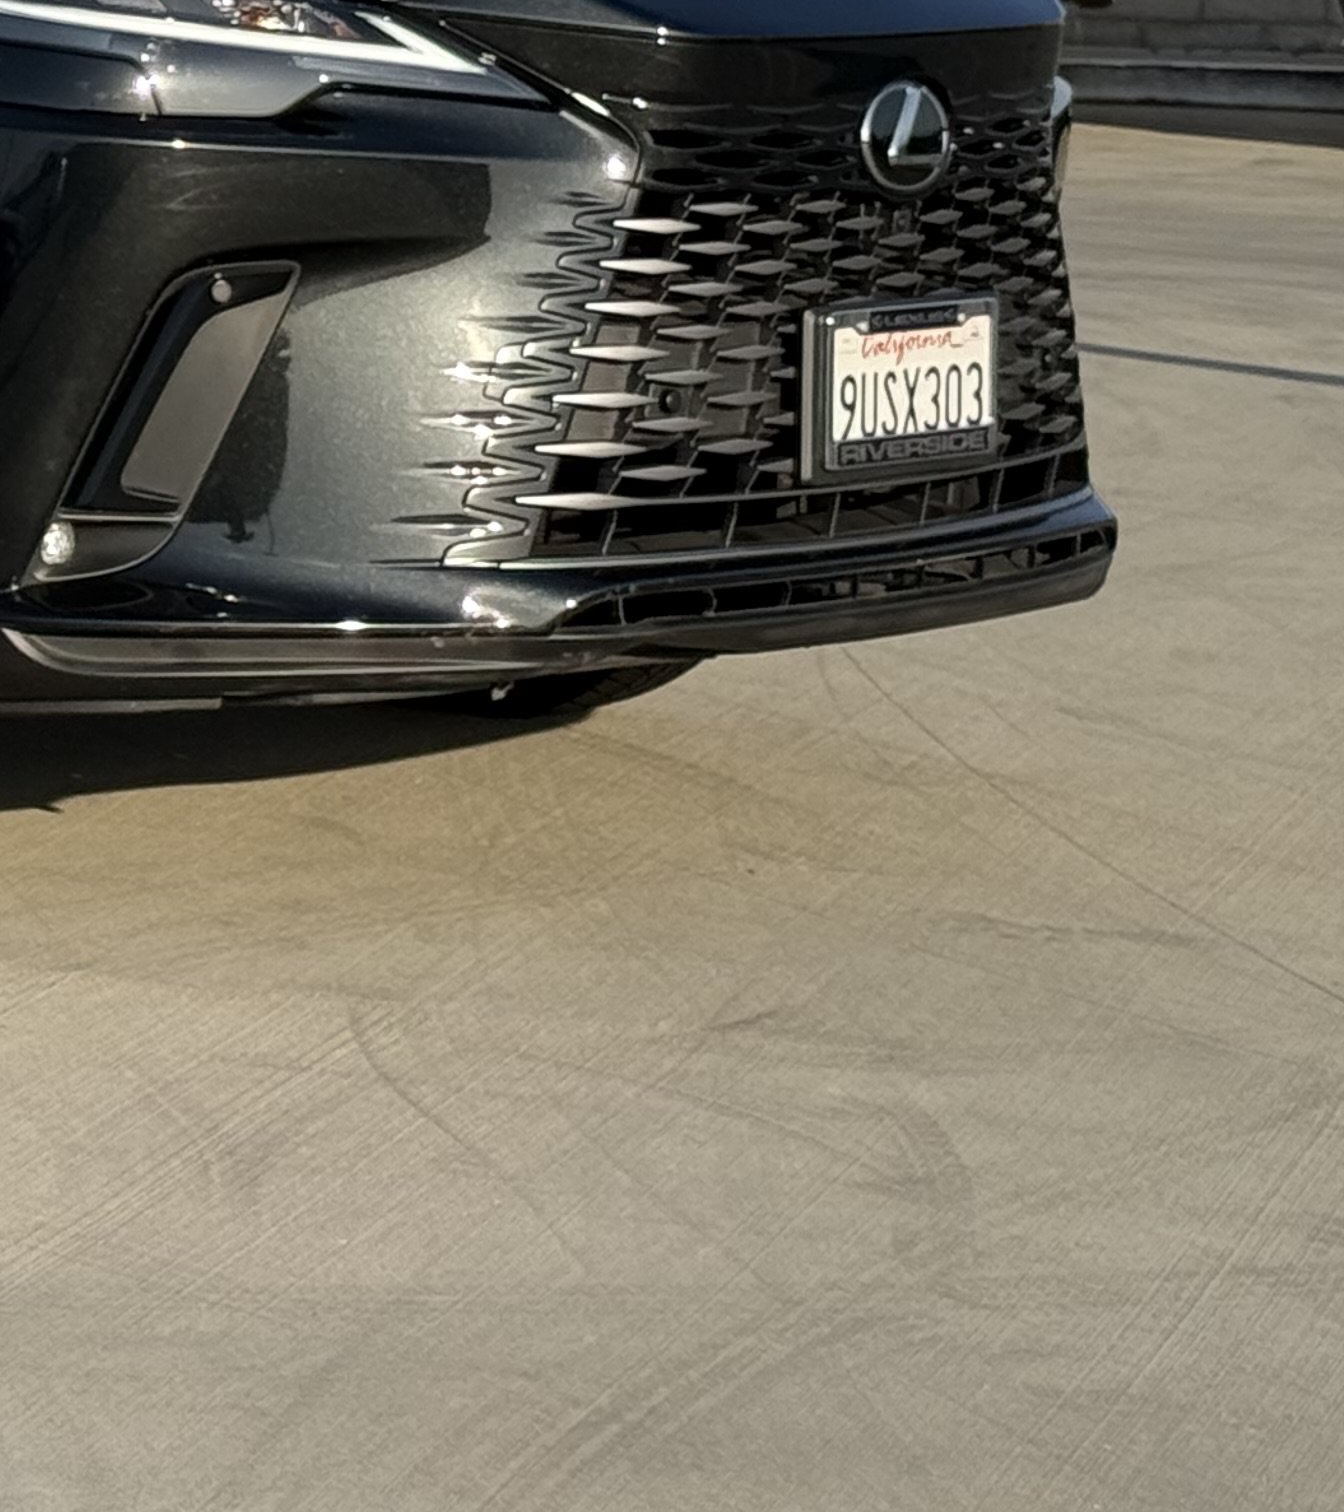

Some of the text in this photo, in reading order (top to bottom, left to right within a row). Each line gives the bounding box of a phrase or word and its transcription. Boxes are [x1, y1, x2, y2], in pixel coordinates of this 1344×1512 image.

[862, 331, 963, 366] California
[840, 362, 983, 440] 9USX303
[840, 432, 986, 464] RIVERSIDE
